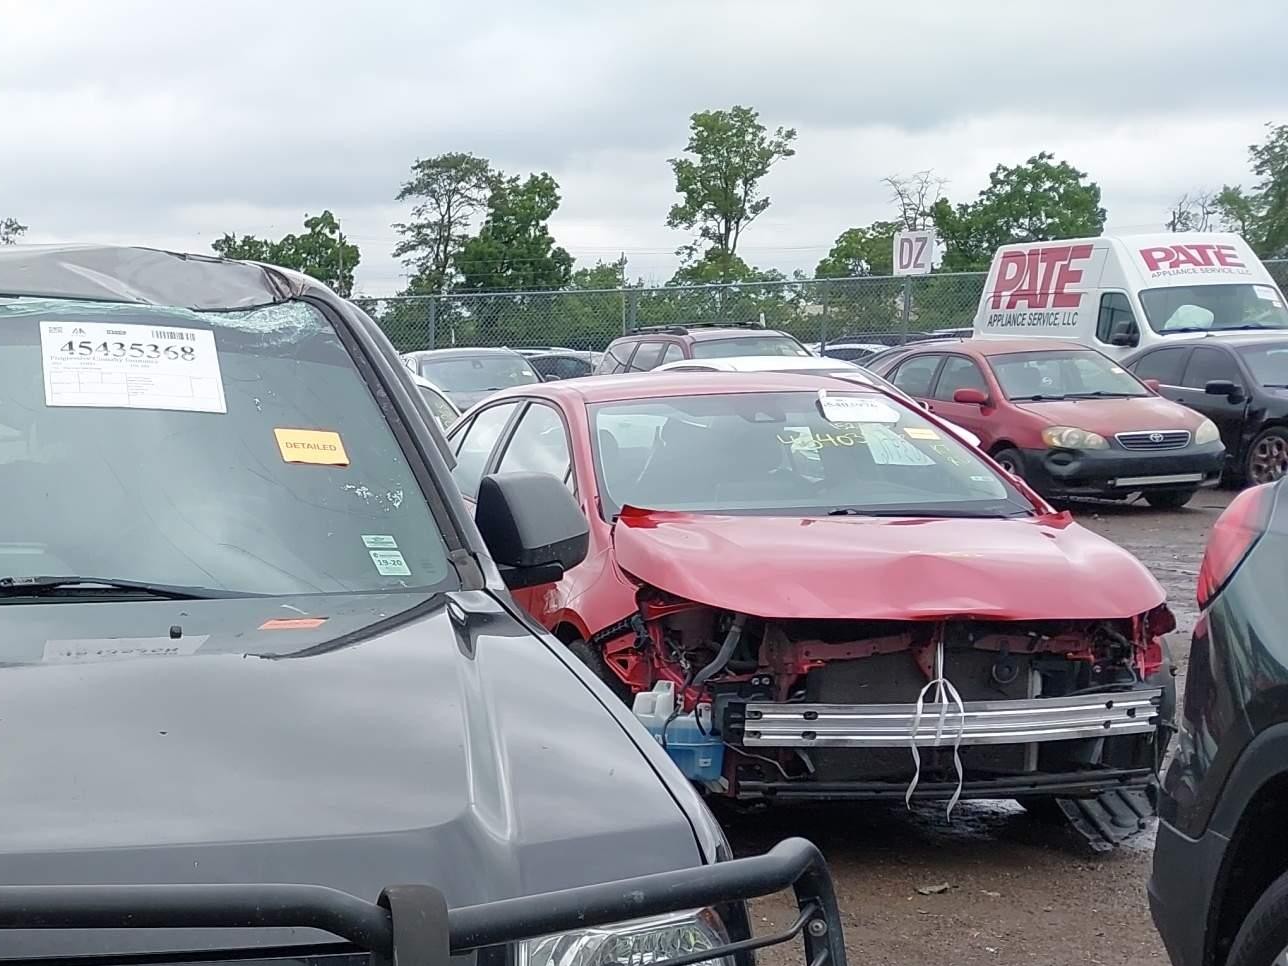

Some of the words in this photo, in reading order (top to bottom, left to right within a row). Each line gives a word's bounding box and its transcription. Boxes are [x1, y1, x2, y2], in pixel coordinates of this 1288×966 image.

[1140, 245, 1246, 271] PATE
[992, 244, 1094, 309] PATE
[1152, 269, 1198, 278] APPLIANCE
[987, 312, 1027, 327] APPLIANCE
[1027, 312, 1061, 328] SERVICE,
[1062, 311, 1079, 326] LLC
[60, 340, 196, 362] 45435368
[285, 441, 337, 451] DETAILED
